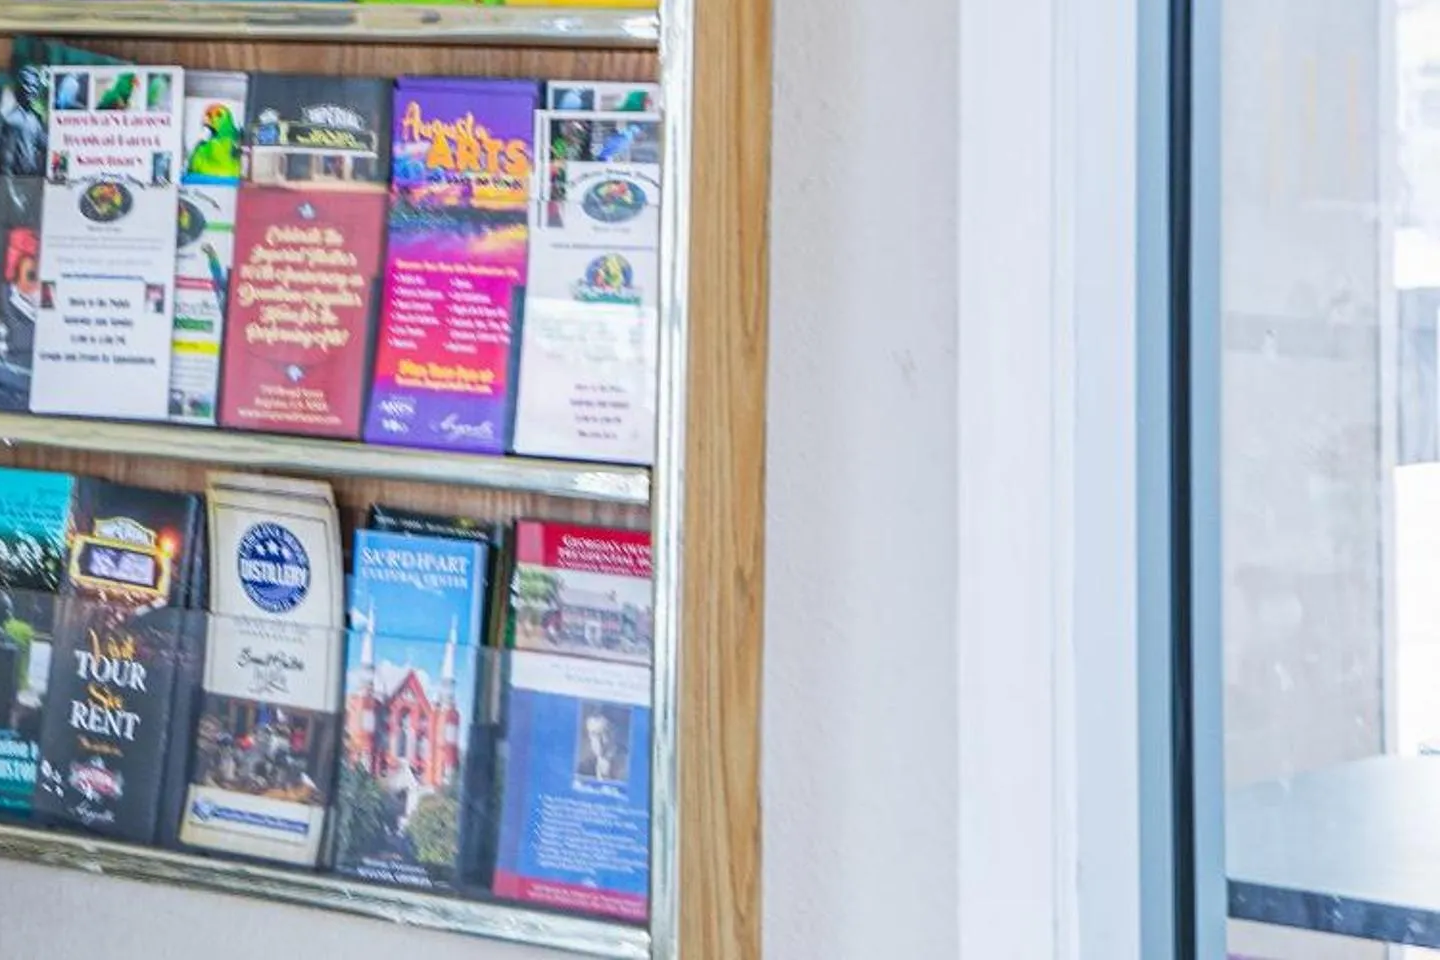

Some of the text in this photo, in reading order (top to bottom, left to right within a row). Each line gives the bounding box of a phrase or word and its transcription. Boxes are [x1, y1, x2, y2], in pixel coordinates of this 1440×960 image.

[427, 132, 532, 176] ARTS
[240, 557, 308, 588] DISTILLERY
[74, 649, 148, 692] TOUR
[70, 700, 142, 741] RENT
